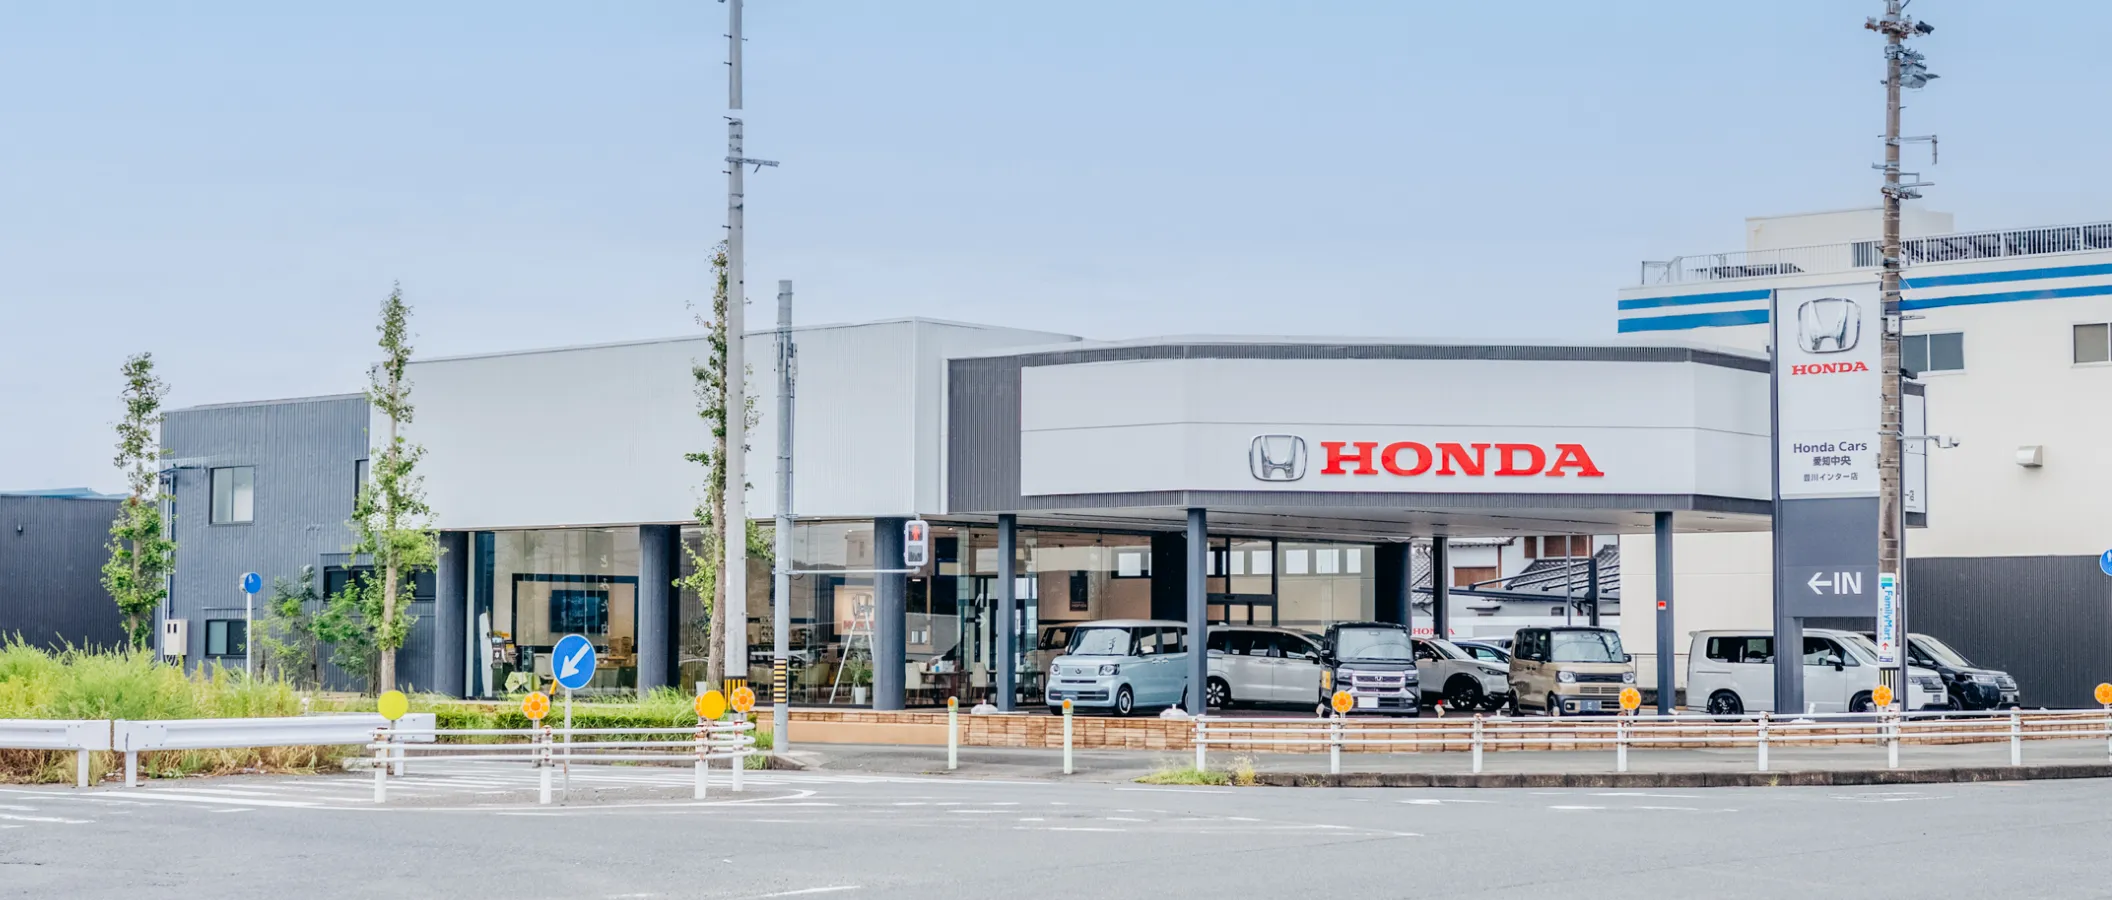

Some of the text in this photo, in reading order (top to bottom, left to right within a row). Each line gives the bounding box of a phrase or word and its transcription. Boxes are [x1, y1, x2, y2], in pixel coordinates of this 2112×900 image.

[1791, 361, 1869, 375] HONDA
[1793, 441, 1868, 454] Honda Cars
[1320, 441, 1605, 477] HONDA
[1813, 455, 1852, 466] 愛知中央
[1803, 472, 1859, 482] 豊川インター店
[1833, 571, 1862, 595] IN
[1883, 590, 1894, 640] FamilyMart
